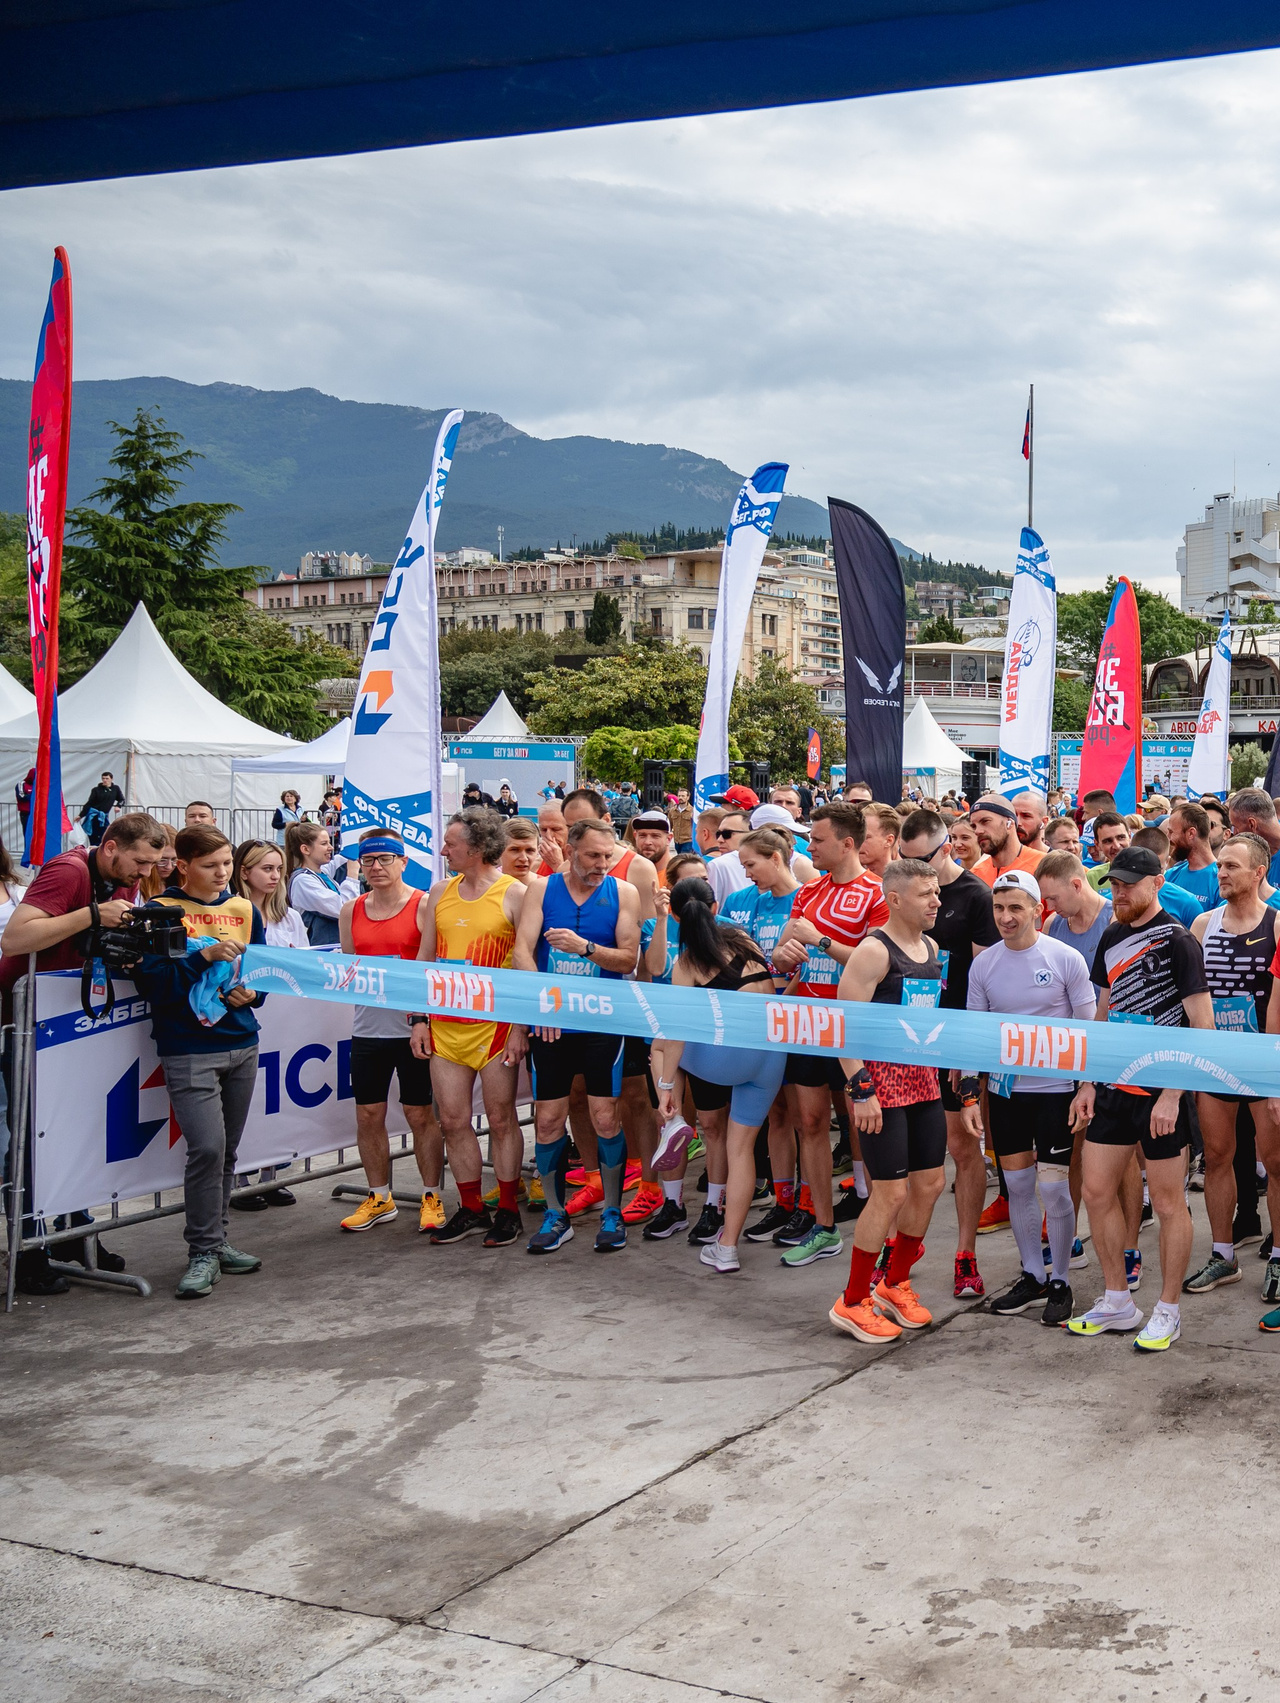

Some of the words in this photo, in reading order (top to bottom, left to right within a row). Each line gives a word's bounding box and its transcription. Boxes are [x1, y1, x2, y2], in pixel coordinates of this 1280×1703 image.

[493, 747, 506, 757] БЕГУ
[507, 748, 514, 757] ЗА
[846, 896, 858, 906] pt
[185, 912, 245, 928] ОЛОНТЕР
[555, 960, 592, 976] 30024
[808, 957, 838, 973] 40189
[425, 968, 495, 1013] СТАРТ
[567, 992, 614, 1016] ПСБ
[74, 1001, 151, 1033] ЗАБЕ
[766, 1001, 845, 1048] СТАРТ
[1215, 1009, 1246, 1026] 40152
[1000, 1022, 1087, 1072] СТАРТ
[1154, 1049, 1195, 1065] #ВОСТОРГ
[1193, 1056, 1242, 1091] #АДРЕНАЛИН
